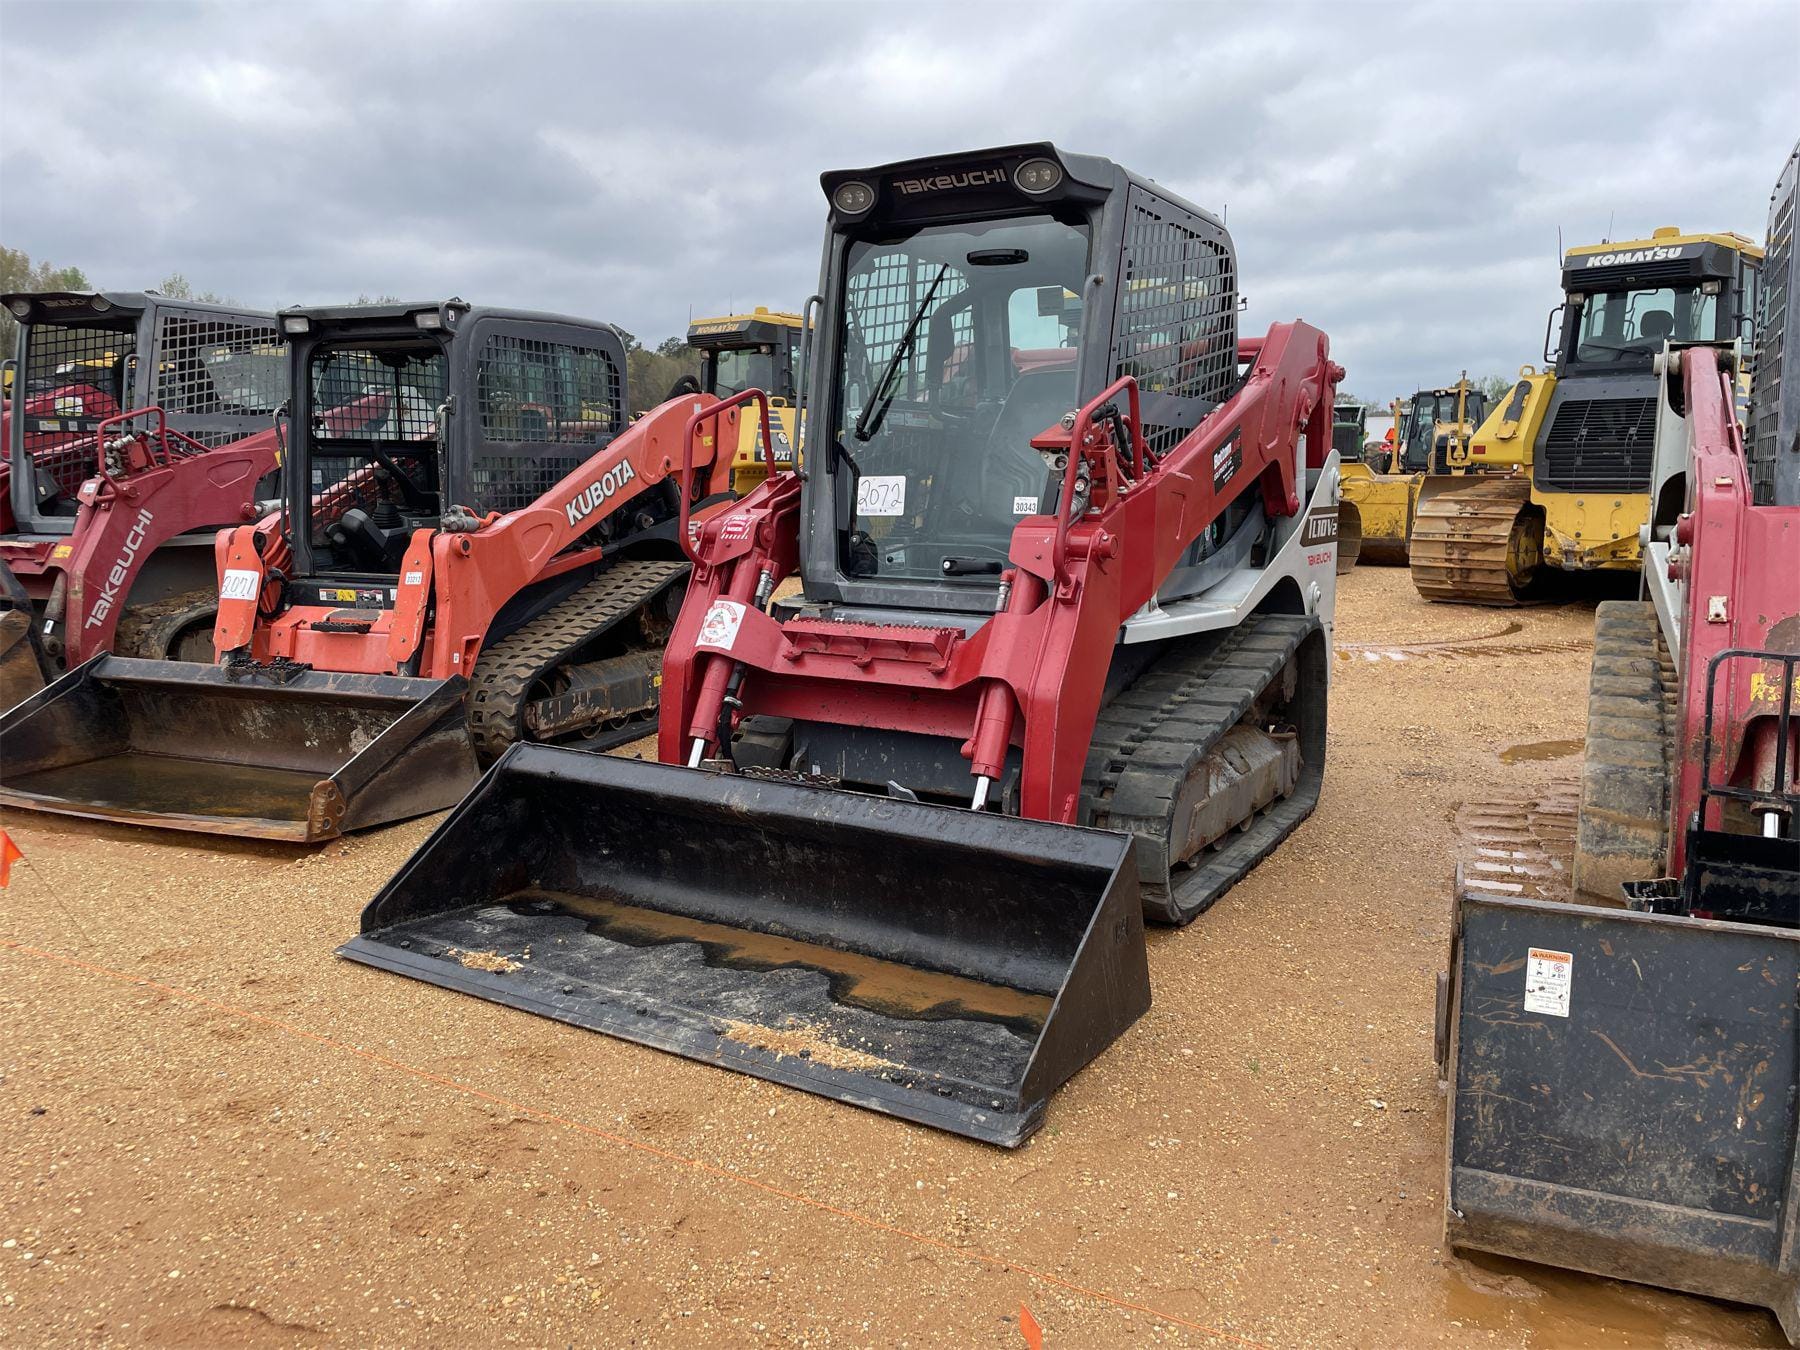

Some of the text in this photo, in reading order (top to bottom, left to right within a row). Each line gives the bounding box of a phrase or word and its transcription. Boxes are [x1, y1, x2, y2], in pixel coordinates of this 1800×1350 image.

[892, 168, 1007, 195] TAKEUCHI
[1586, 247, 1683, 268] KOMATSU
[696, 323, 740, 335] KOMATSU
[565, 458, 636, 527] KUBOTA
[858, 479, 903, 507] 2072
[1015, 502, 1037, 512] 30343
[1308, 513, 1338, 539] TL10V2
[84, 508, 154, 630] TAKEUCHI
[221, 575, 255, 595] 2071
[1539, 951, 1569, 962] WARNING
